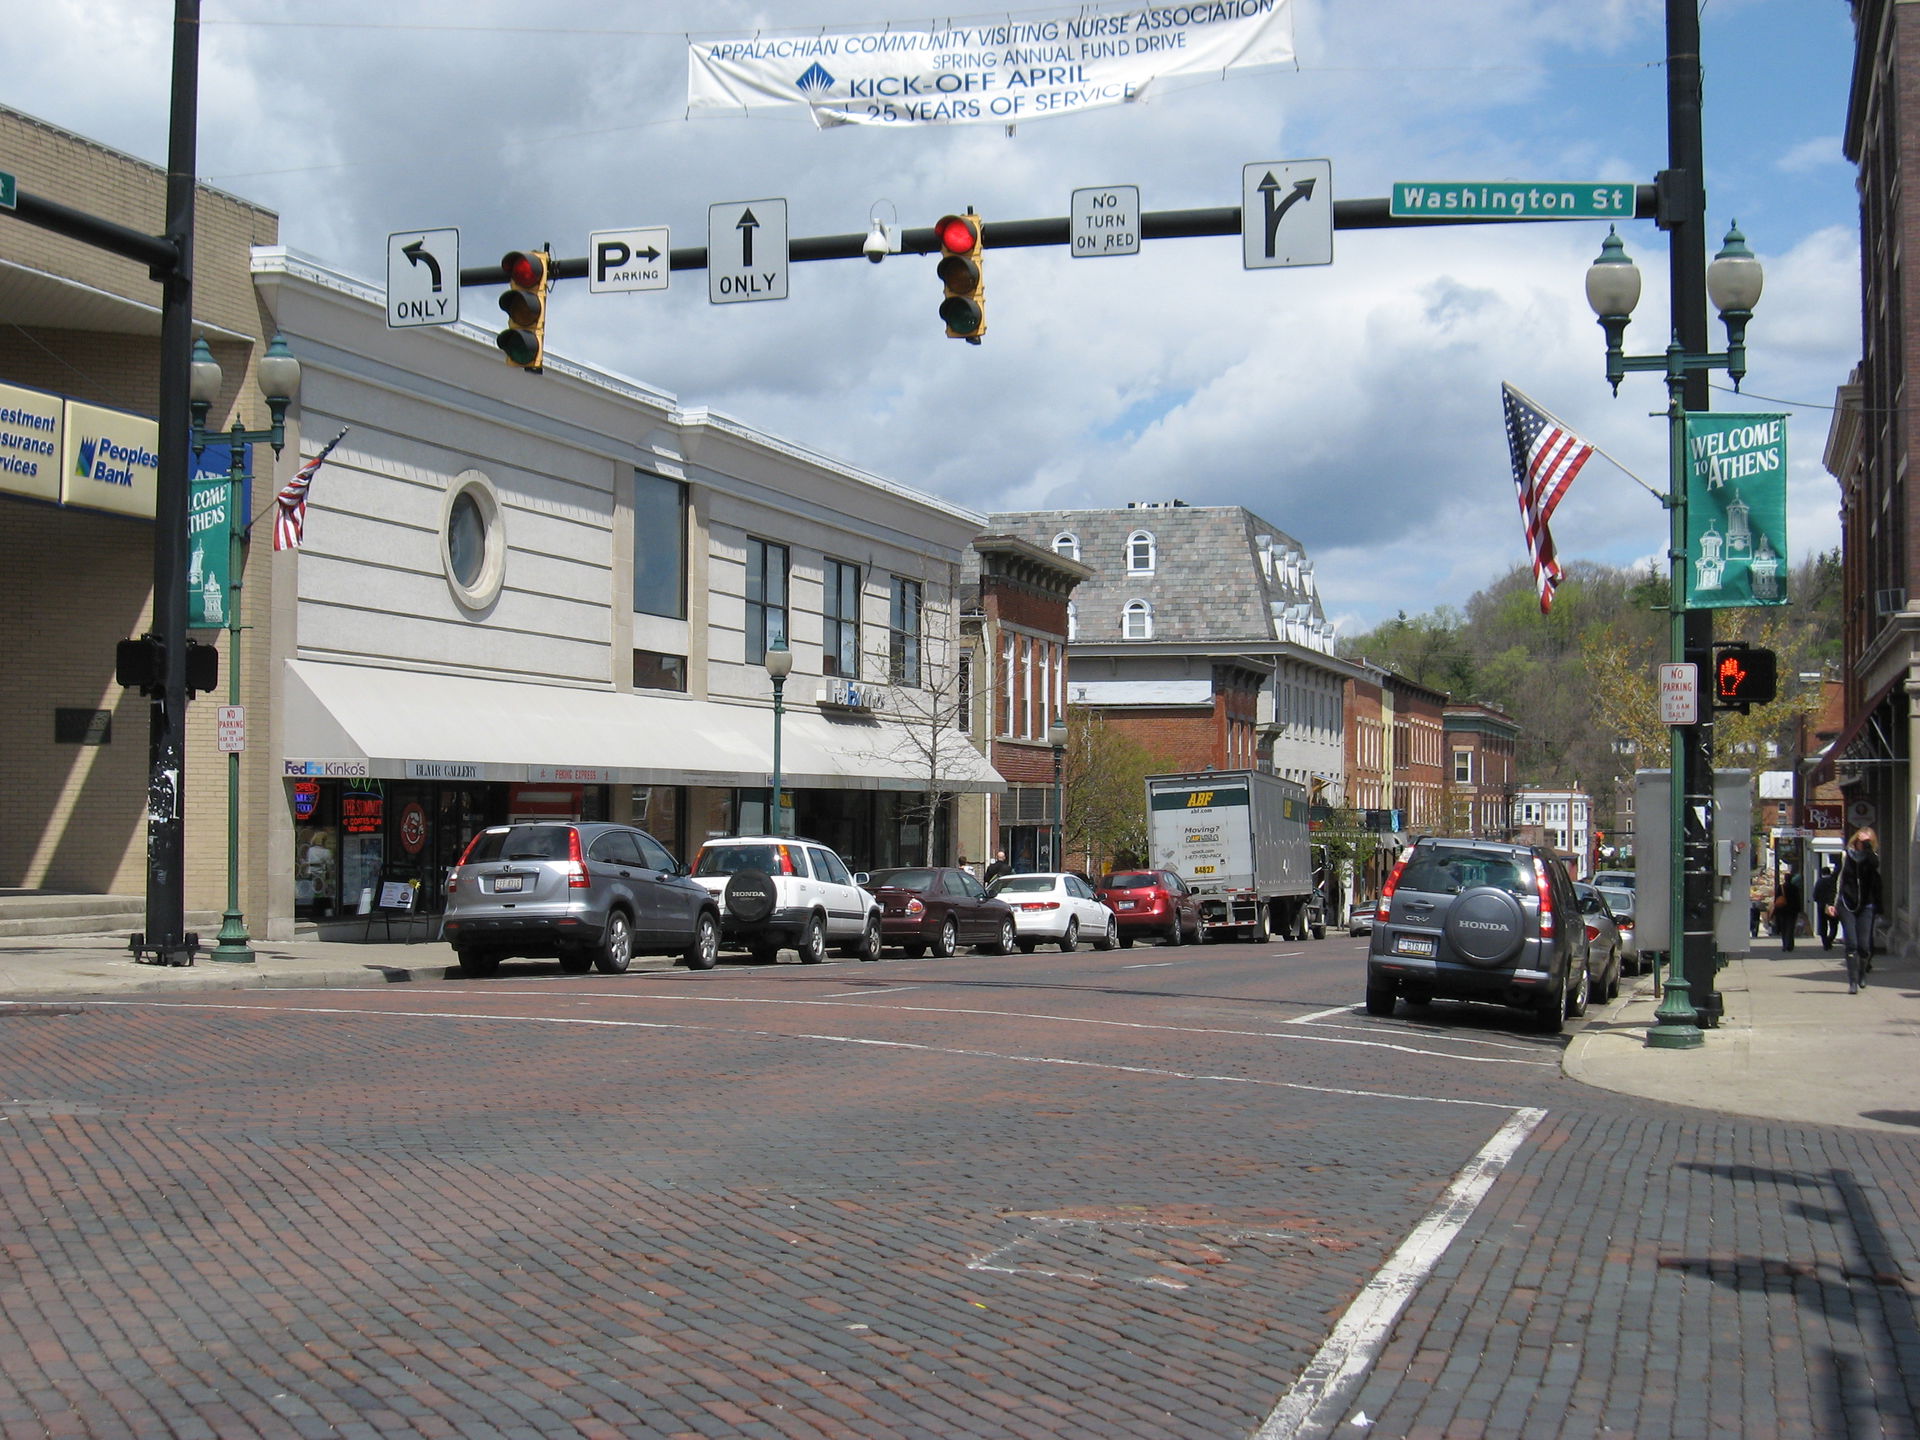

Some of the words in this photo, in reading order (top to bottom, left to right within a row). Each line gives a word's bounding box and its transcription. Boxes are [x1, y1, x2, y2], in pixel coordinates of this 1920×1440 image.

[708, 36, 839, 61] APPALACHIAN
[845, 30, 972, 55] COMMUNITY
[979, 22, 1059, 47] VISITING
[1067, 15, 1130, 40] NURSE
[1135, 0, 1275, 32] ASSOCIATION
[932, 51, 998, 71] SPRING
[1003, 46, 1076, 67] ANNUAL
[1081, 40, 1131, 60] FUND
[1135, 32, 1187, 54] DRIVE
[850, 71, 997, 98] KICK-OFF
[1006, 64, 1091, 90] APRIL
[904, 98, 981, 122] YEARS
[990, 95, 1025, 116] OF
[1034, 81, 1137, 112] SERVICE
[1092, 195, 1118, 209] NO
[1403, 187, 1576, 215] Washington
[1592, 188, 1624, 209] St
[1085, 213, 1126, 229] TURN
[1076, 234, 1097, 249] ON
[1106, 232, 1134, 248] RED
[719, 272, 777, 294] ONLY
[397, 298, 449, 319] ONLY
[1690, 419, 1781, 461] WELCOME
[97, 437, 159, 469] Peoples
[93, 461, 135, 488] Bank
[1693, 461, 1708, 476] TO
[1706, 447, 1780, 492] ATHENS
[187, 484, 228, 513] LCOME
[187, 505, 226, 535] THENS
[1670, 669, 1684, 680] NO
[1662, 682, 1693, 693] PARKING
[226, 709, 236, 719] NO
[1668, 711, 1686, 719] DAILY
[219, 720, 245, 729] PARKING
[325, 761, 366, 776] Kinko's
[415, 764, 442, 778] BLAIR
[444, 764, 477, 779] GALLERY
[574, 769, 597, 780] EXPRESS
[1186, 791, 1214, 808] ABF
[1808, 808, 1828, 823] Red
[1184, 825, 1220, 834] Moving?
[1458, 919, 1510, 932] HONDA
